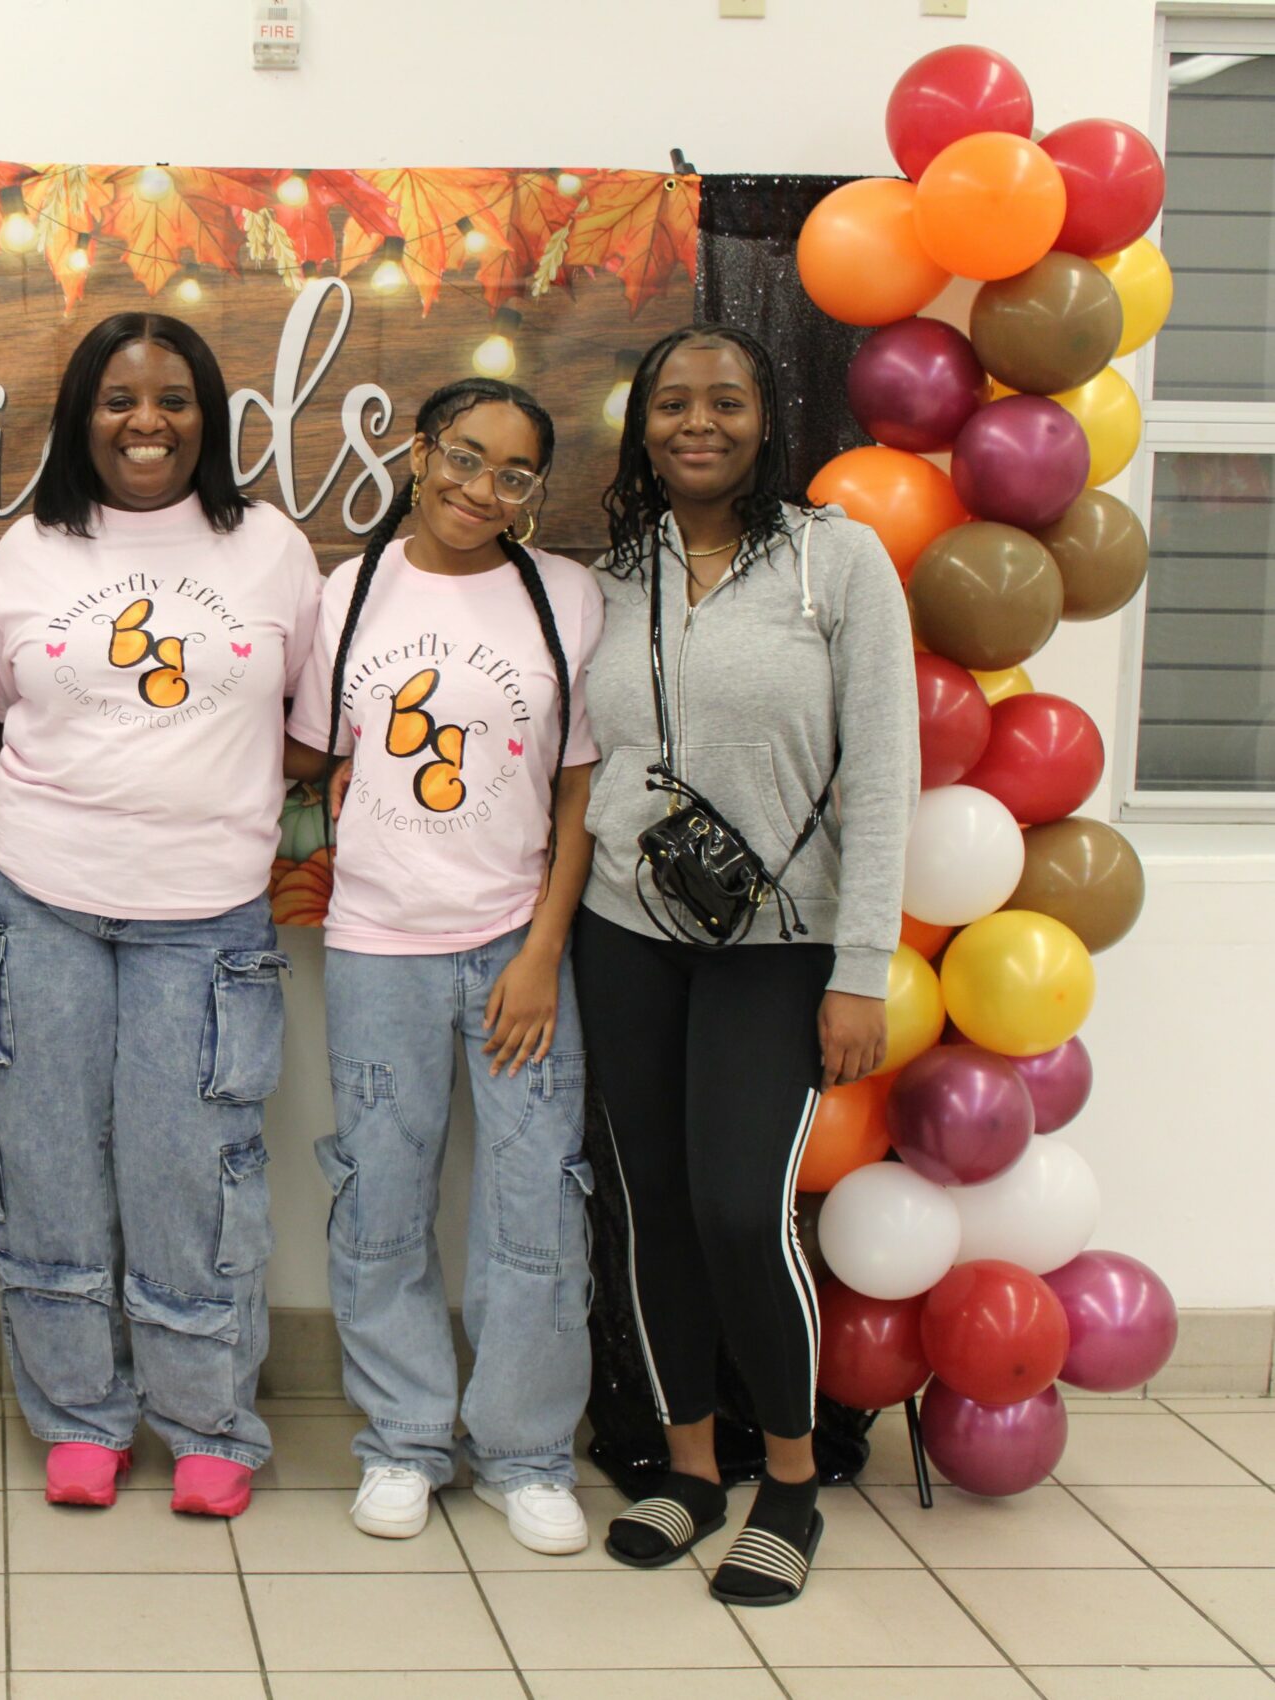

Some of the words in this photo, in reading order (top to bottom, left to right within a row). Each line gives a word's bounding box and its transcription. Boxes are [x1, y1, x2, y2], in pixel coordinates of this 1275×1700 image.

[260, 25, 294, 38] FIRE
[47, 572, 166, 633] Butterfly
[173, 576, 245, 634] Effect
[54, 664, 95, 706] Girls
[96, 695, 218, 729] Mentoring
[211, 663, 248, 697] Inc.
[342, 632, 458, 711] Butterfly
[464, 641, 532, 727] Effect
[353, 766, 371, 804] irls
[370, 797, 493, 835] Mentoring
[484, 762, 520, 799] Inc.
